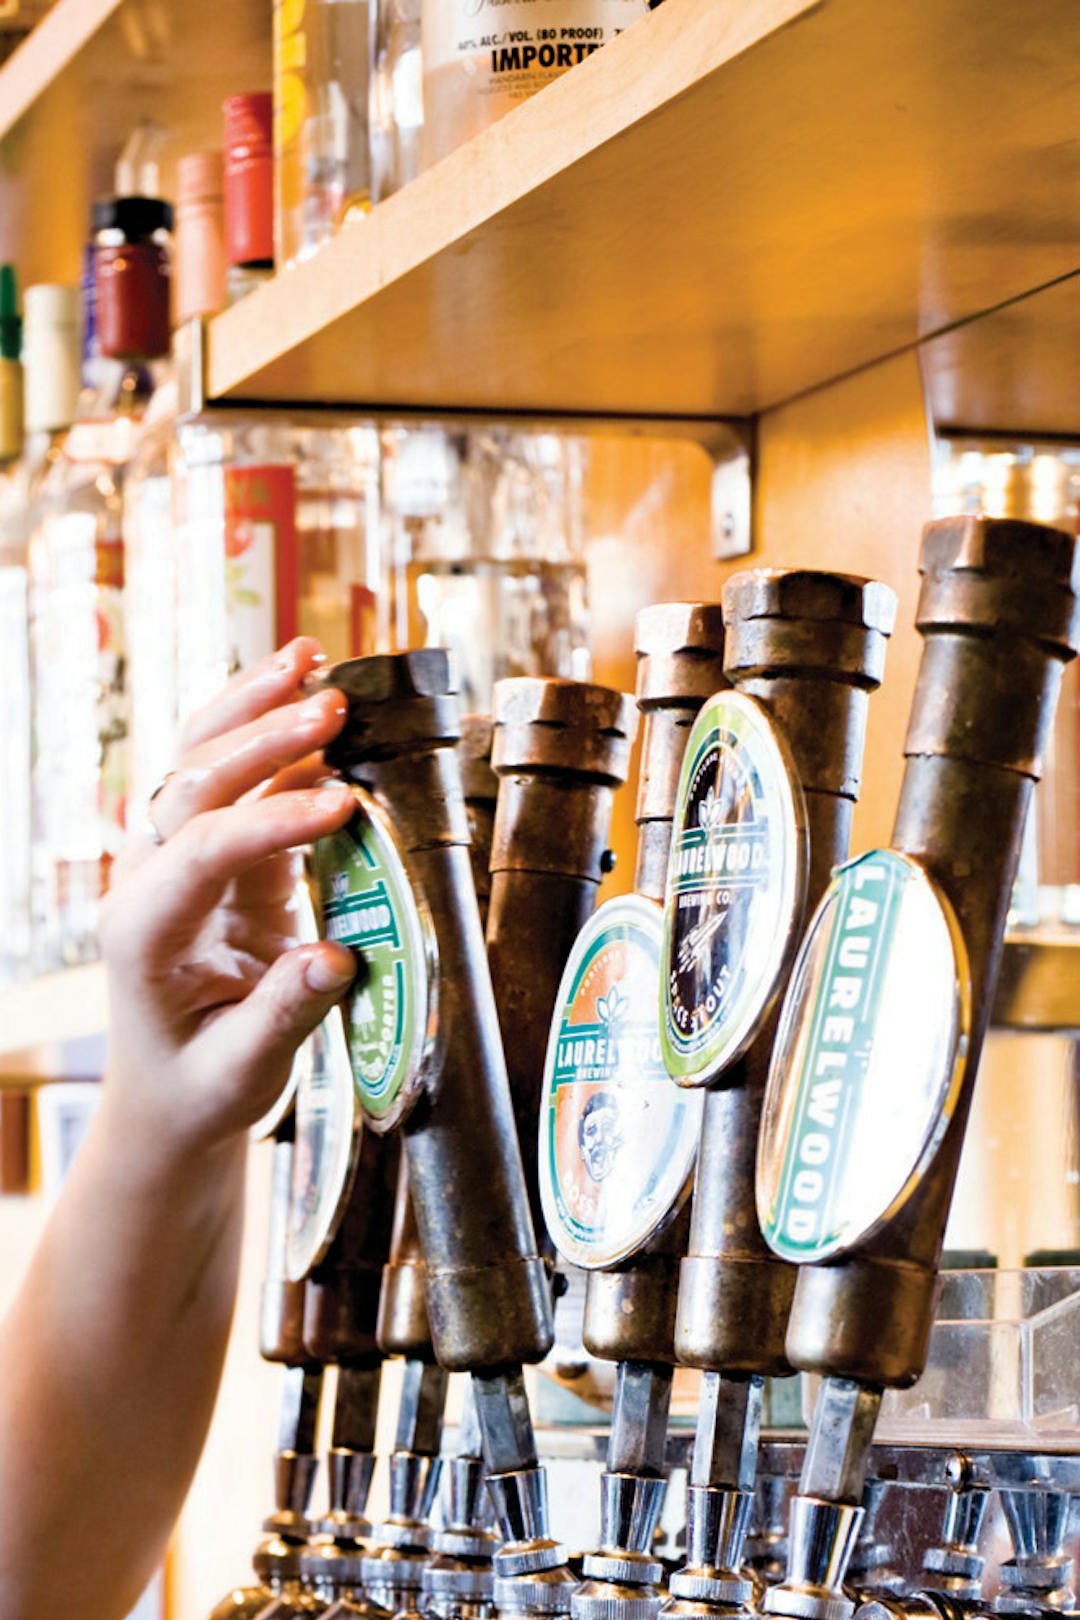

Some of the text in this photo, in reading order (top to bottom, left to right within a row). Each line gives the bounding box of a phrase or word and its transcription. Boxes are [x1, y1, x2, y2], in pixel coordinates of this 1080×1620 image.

[481, 29, 533, 46] ALC./VOL.
[537, 28, 557, 41] (80
[561, 27, 604, 40] PROOF)
[492, 43, 605, 72] IMPORTE
[785, 863, 886, 1242] LAURELWOOD
